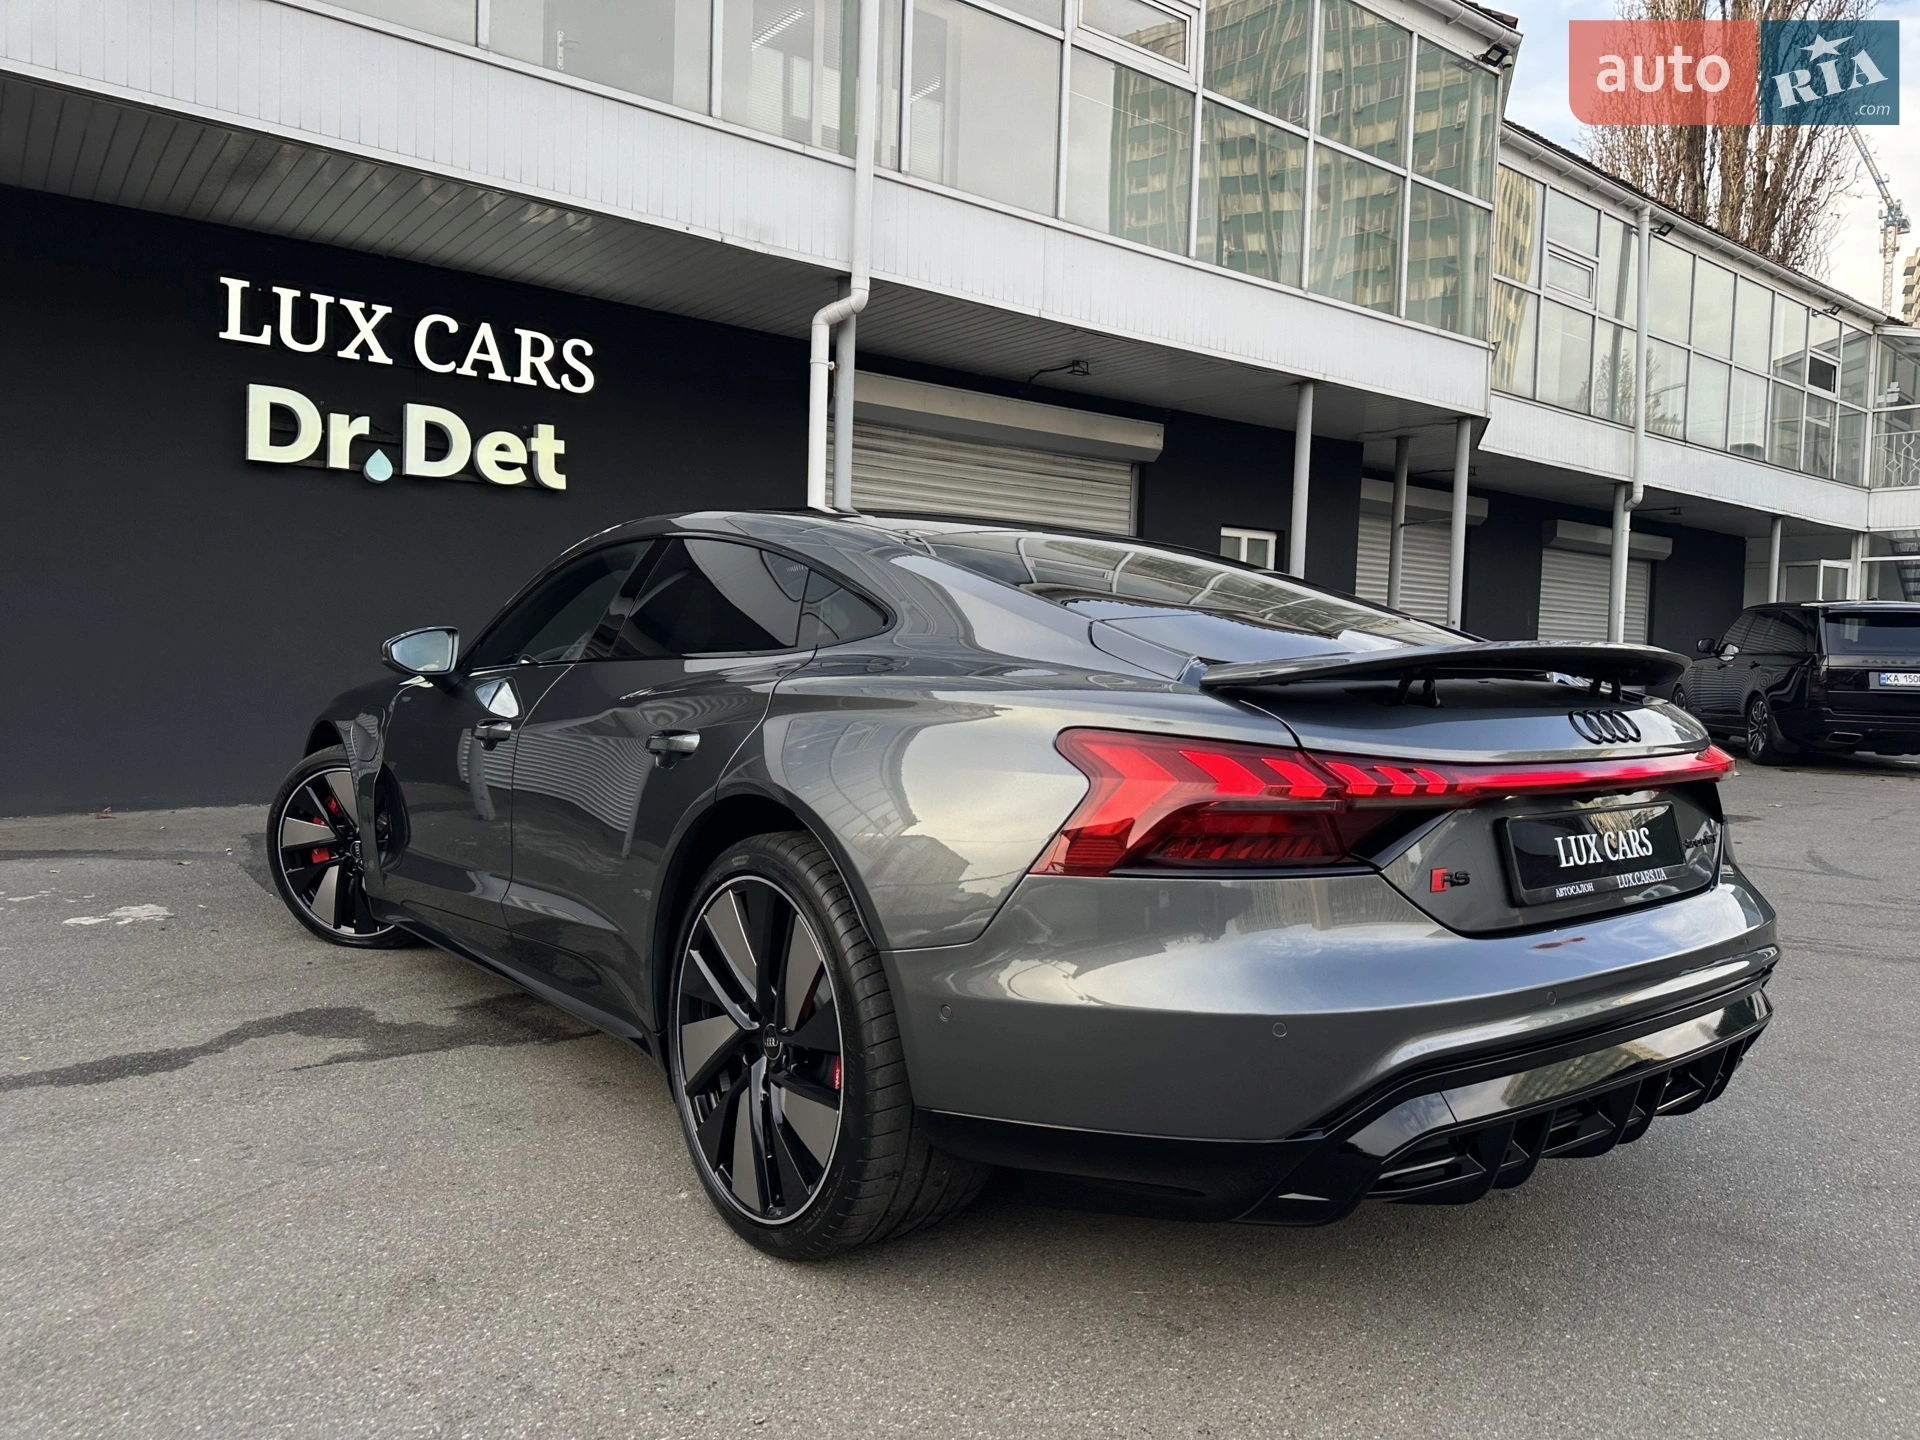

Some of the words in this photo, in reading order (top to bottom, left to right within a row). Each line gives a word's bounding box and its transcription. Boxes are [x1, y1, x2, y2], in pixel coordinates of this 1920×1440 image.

[219, 276, 393, 365] LUX
[414, 313, 595, 394] CARS
[1554, 833, 1603, 868] LUX
[1603, 827, 1653, 861] CARS
[1555, 882, 1595, 898] АВТОСАЛОН
[1616, 868, 1668, 889] LUX.CARS.UA
